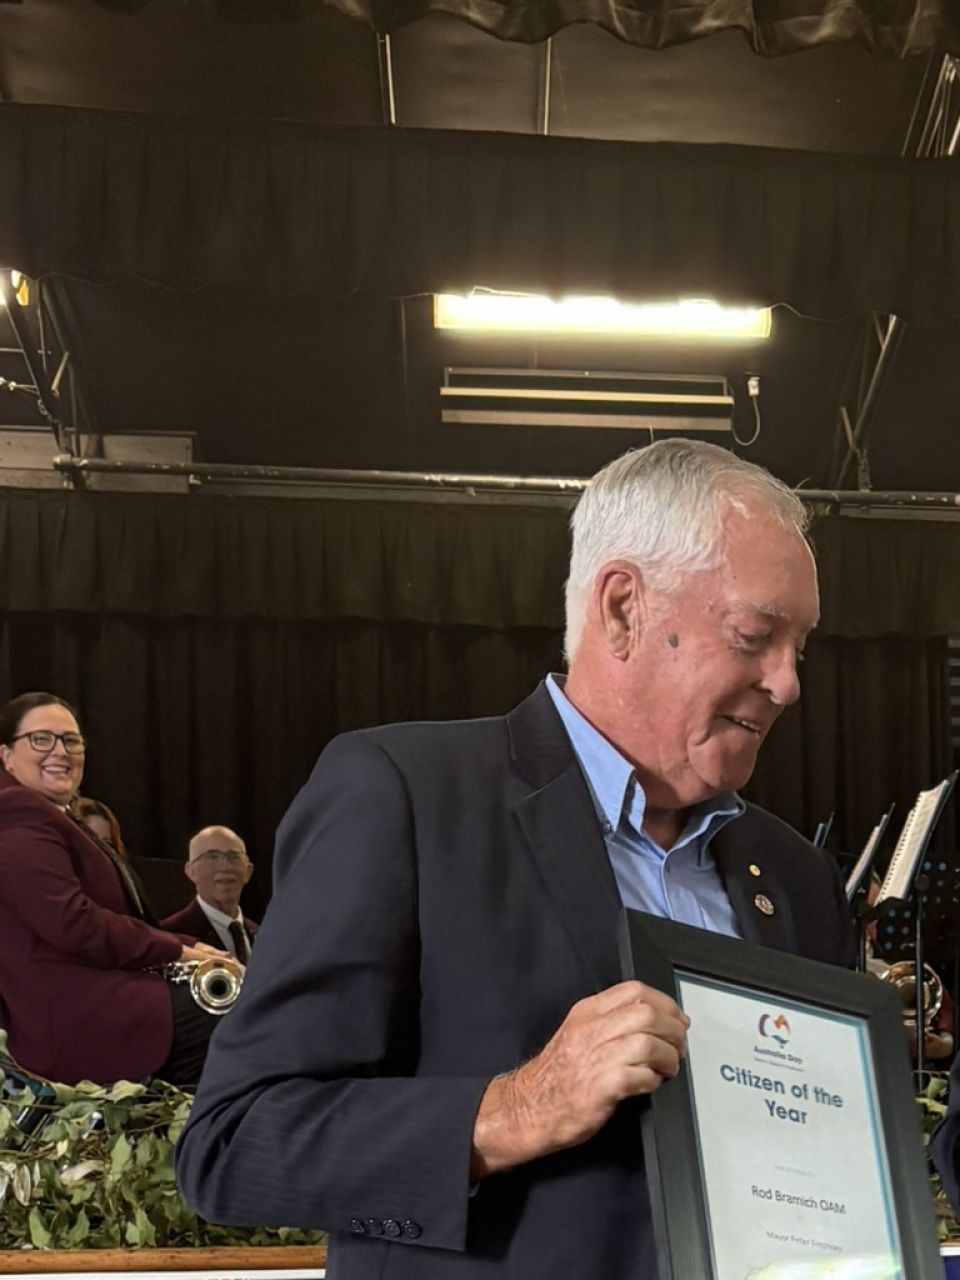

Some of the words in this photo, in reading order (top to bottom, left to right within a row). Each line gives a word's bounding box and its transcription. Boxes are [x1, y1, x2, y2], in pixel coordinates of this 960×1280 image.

[720, 1064, 786, 1096] Citizen
[791, 1083, 809, 1101] of
[813, 1085, 844, 1109] the
[764, 1098, 808, 1125] Year
[751, 1184, 773, 1201] Rod
